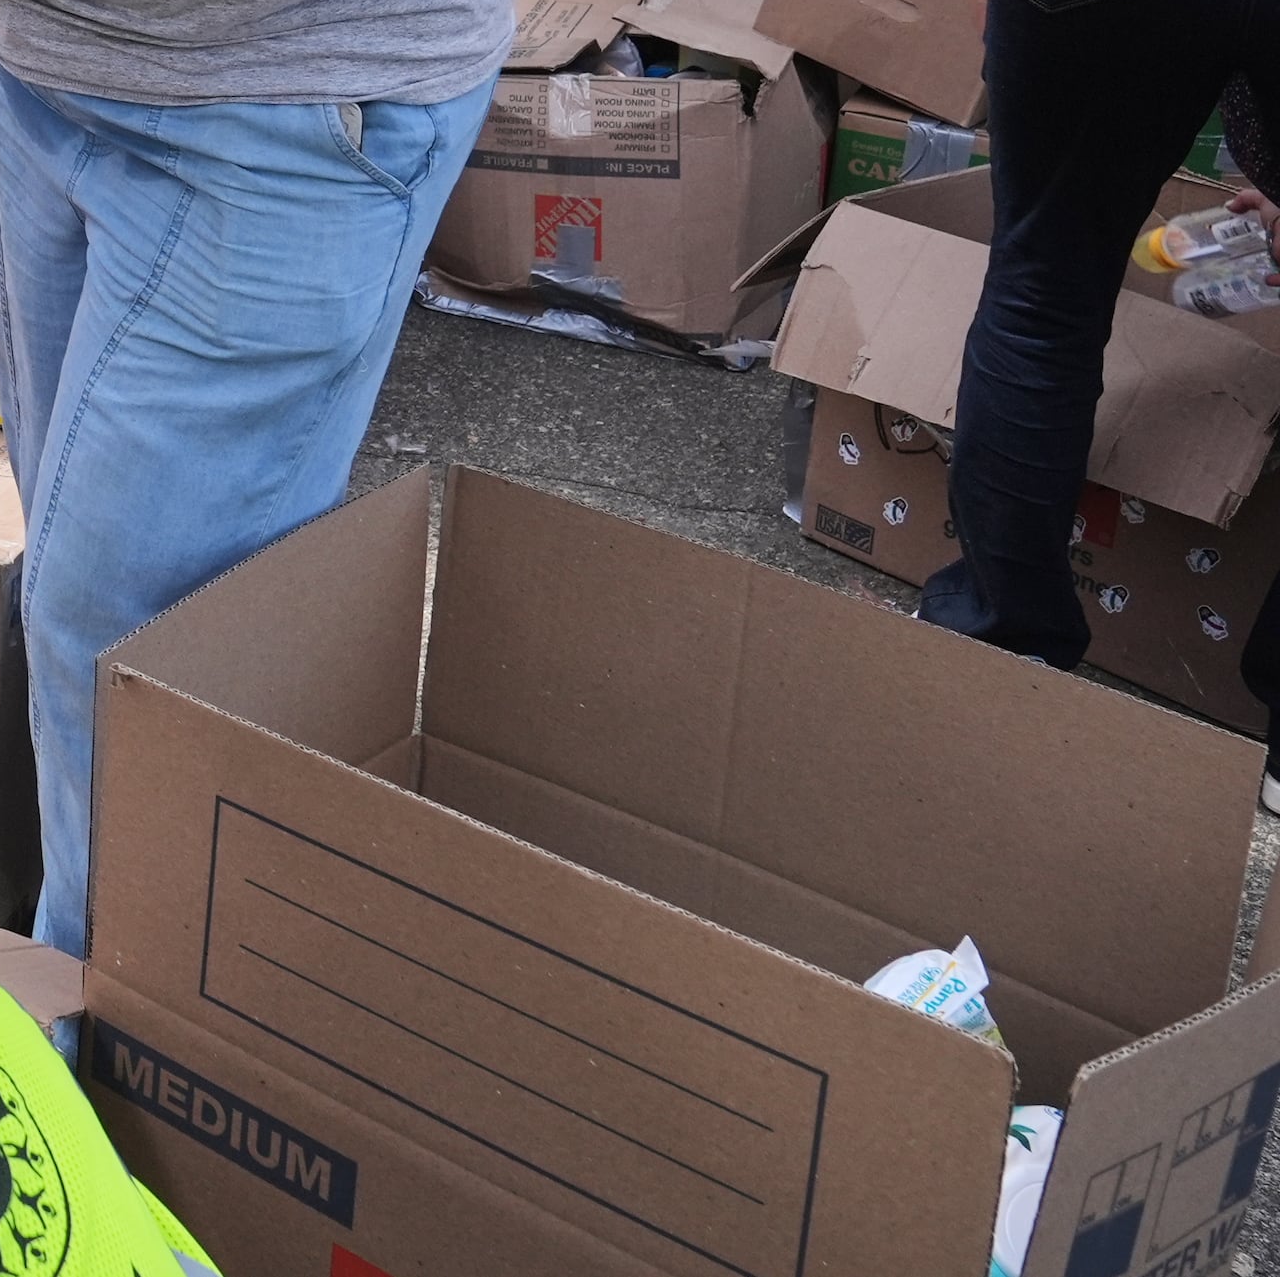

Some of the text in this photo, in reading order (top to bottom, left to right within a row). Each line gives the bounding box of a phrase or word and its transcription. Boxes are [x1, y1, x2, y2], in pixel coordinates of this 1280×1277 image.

[510, 94, 534, 103] ATTIC
[595, 98, 655, 107] DINING ROOM
[594, 121, 655, 130] FAMILY ROOM
[614, 144, 655, 152] PRIMARY
[483, 155, 533, 168] FRAGILE
[606, 162, 670, 173] PLACE IN:
[818, 514, 841, 537] USA
[113, 1041, 332, 1202] MEDIUM
